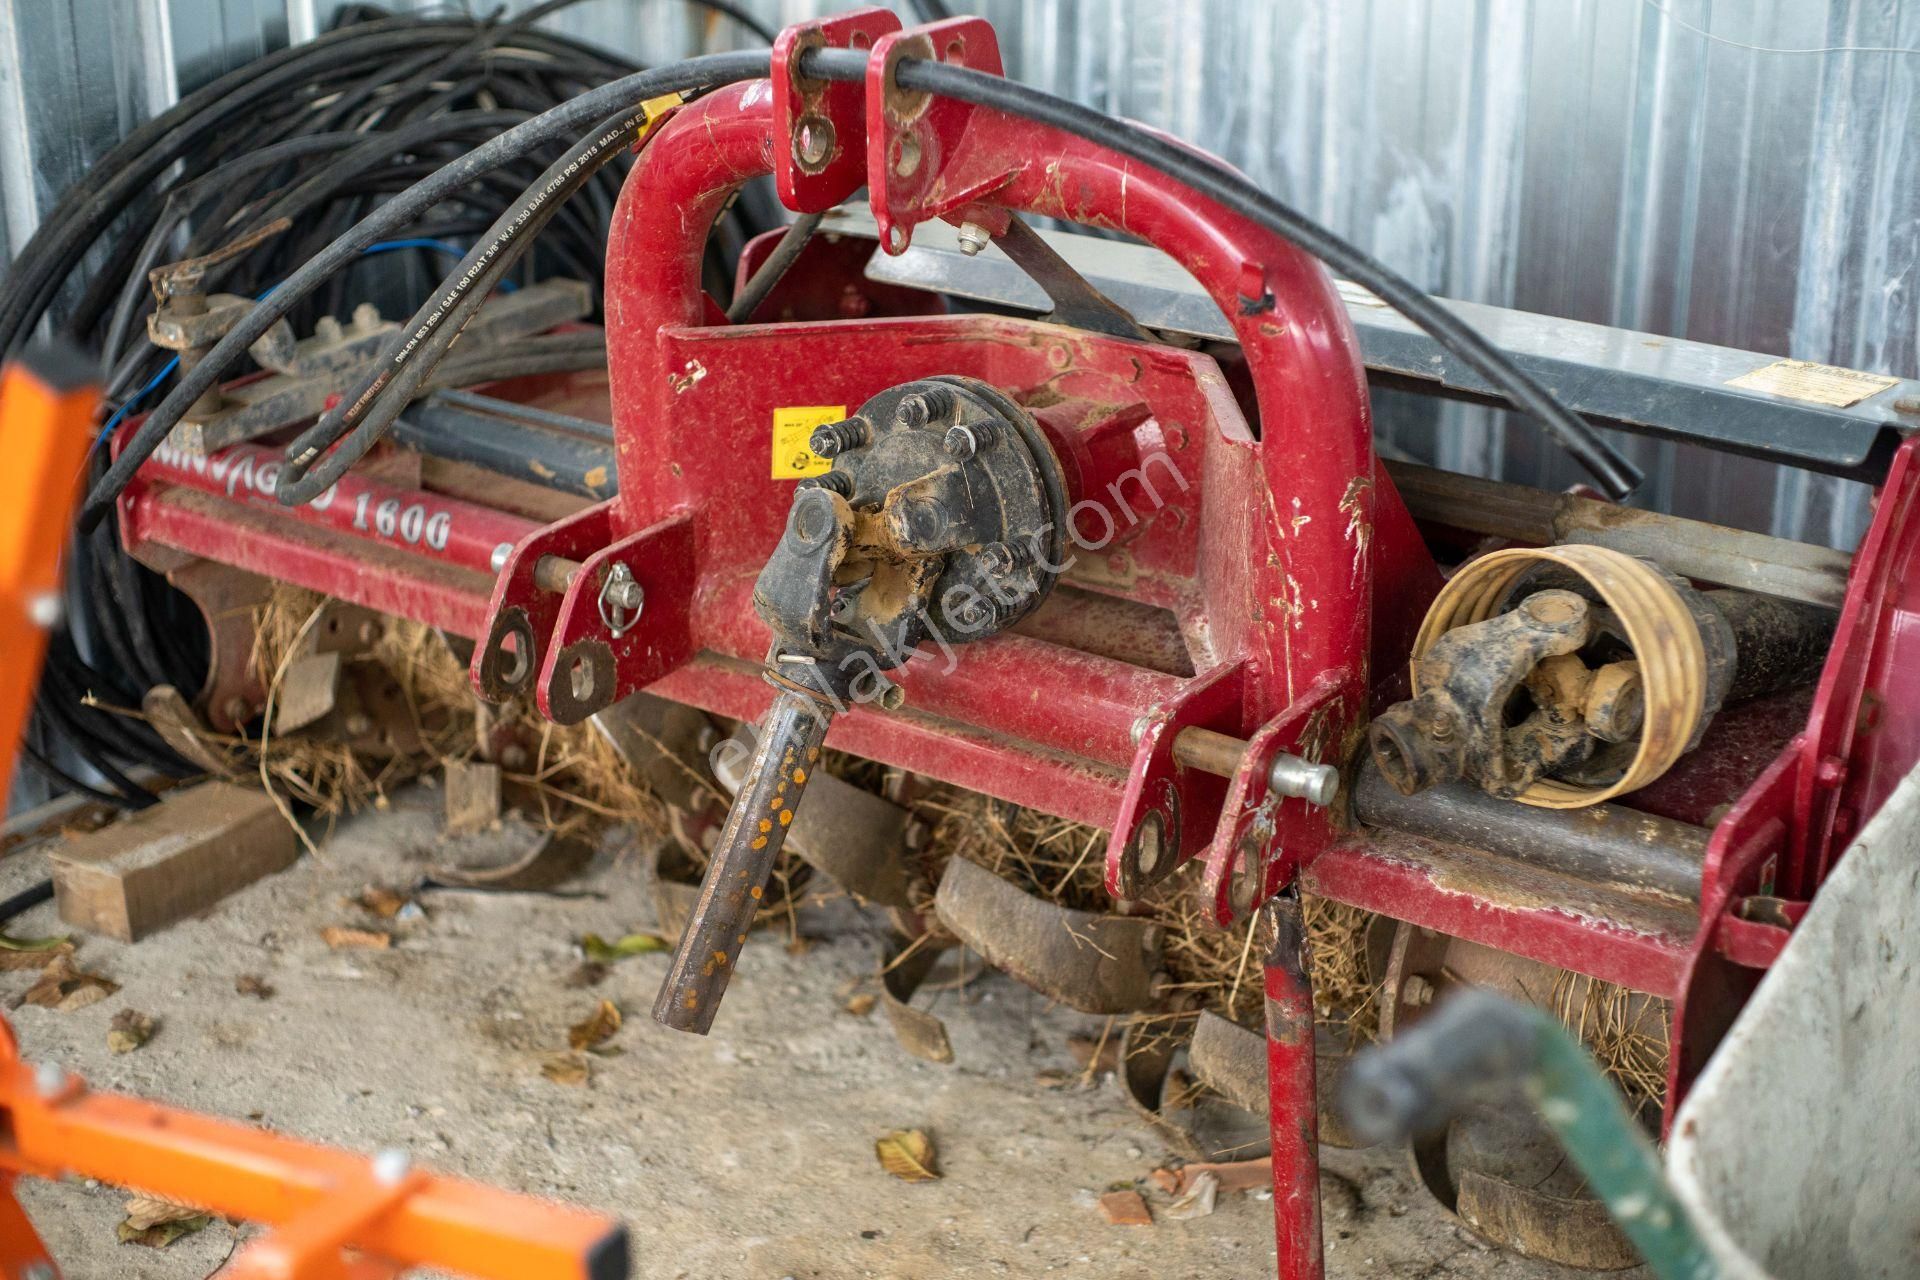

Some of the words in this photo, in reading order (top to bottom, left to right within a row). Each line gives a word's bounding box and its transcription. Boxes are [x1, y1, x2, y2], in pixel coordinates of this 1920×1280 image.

[394, 338, 418, 363] DIN-EN
[426, 310, 442, 327] 2SN
[442, 290, 459, 308] SAE
[456, 276, 471, 291] 100
[467, 255, 488, 278] R2AT
[499, 225, 519, 242] W.P.
[515, 209, 531, 225] 330
[528, 191, 547, 211] BAR
[546, 174, 566, 195] 4785
[563, 161, 580, 177] PSI
[577, 145, 598, 165] 2015
[598, 127, 625, 148] MAD
[624, 118, 635, 129] IN
